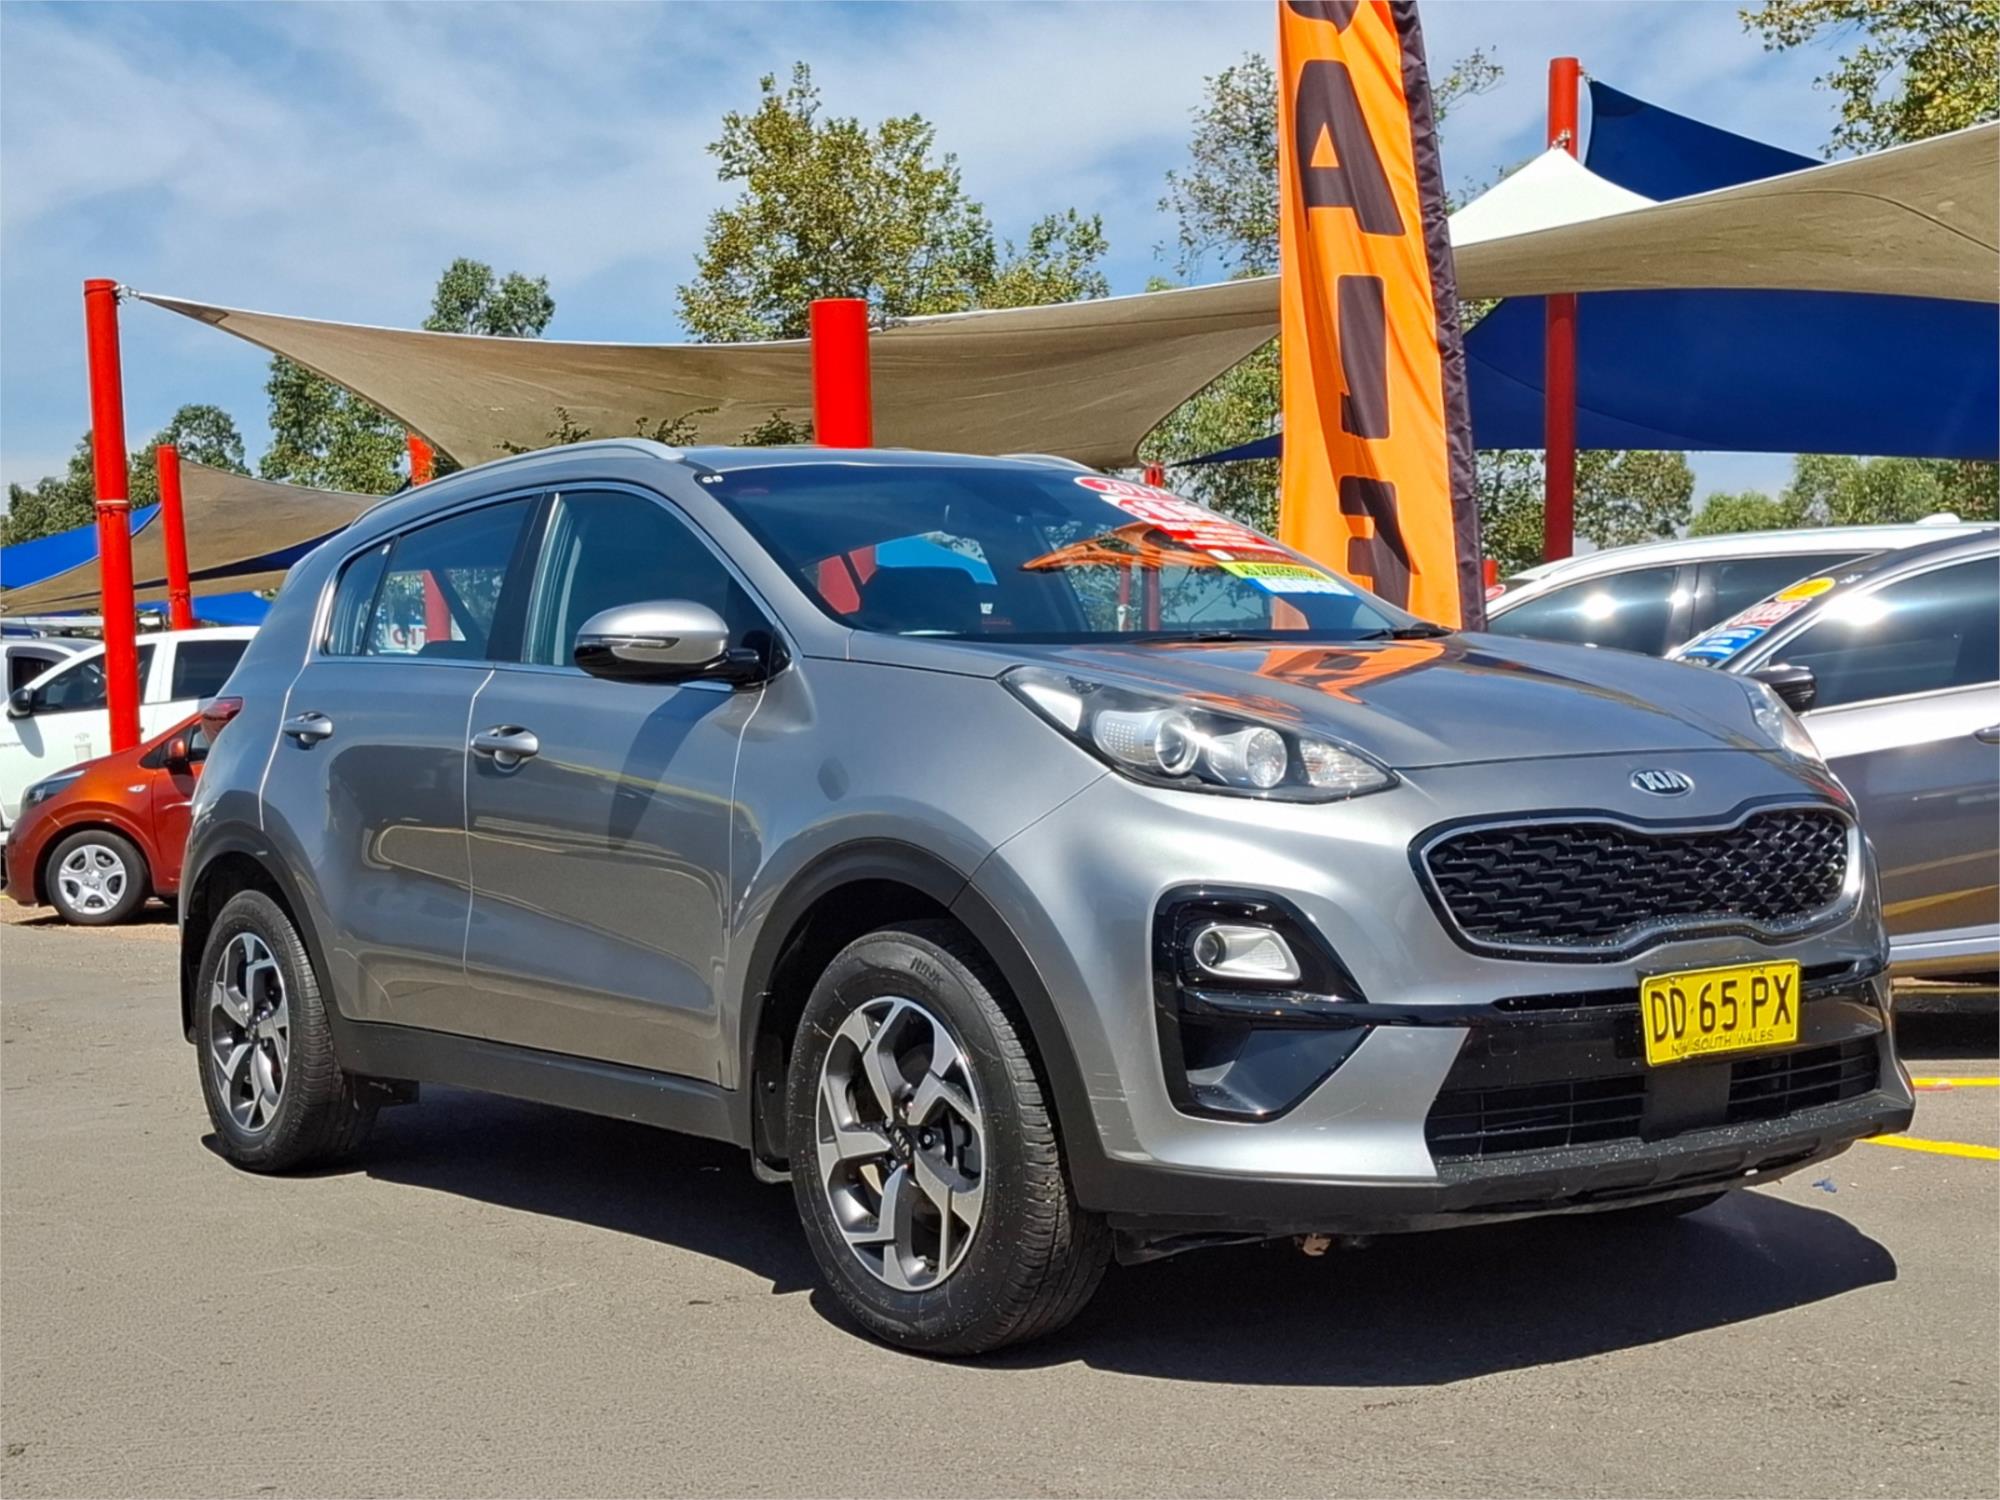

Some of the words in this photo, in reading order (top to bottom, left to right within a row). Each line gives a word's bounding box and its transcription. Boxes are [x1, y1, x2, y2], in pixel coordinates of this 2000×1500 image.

[1638, 771, 1687, 790] KIA
[1650, 986, 1687, 1043] DD
[1699, 980, 1738, 1034] 65
[1751, 974, 1792, 1029] PX
[1692, 1034, 1732, 1052] SOUTH
[1737, 1029, 1775, 1046] WALES
